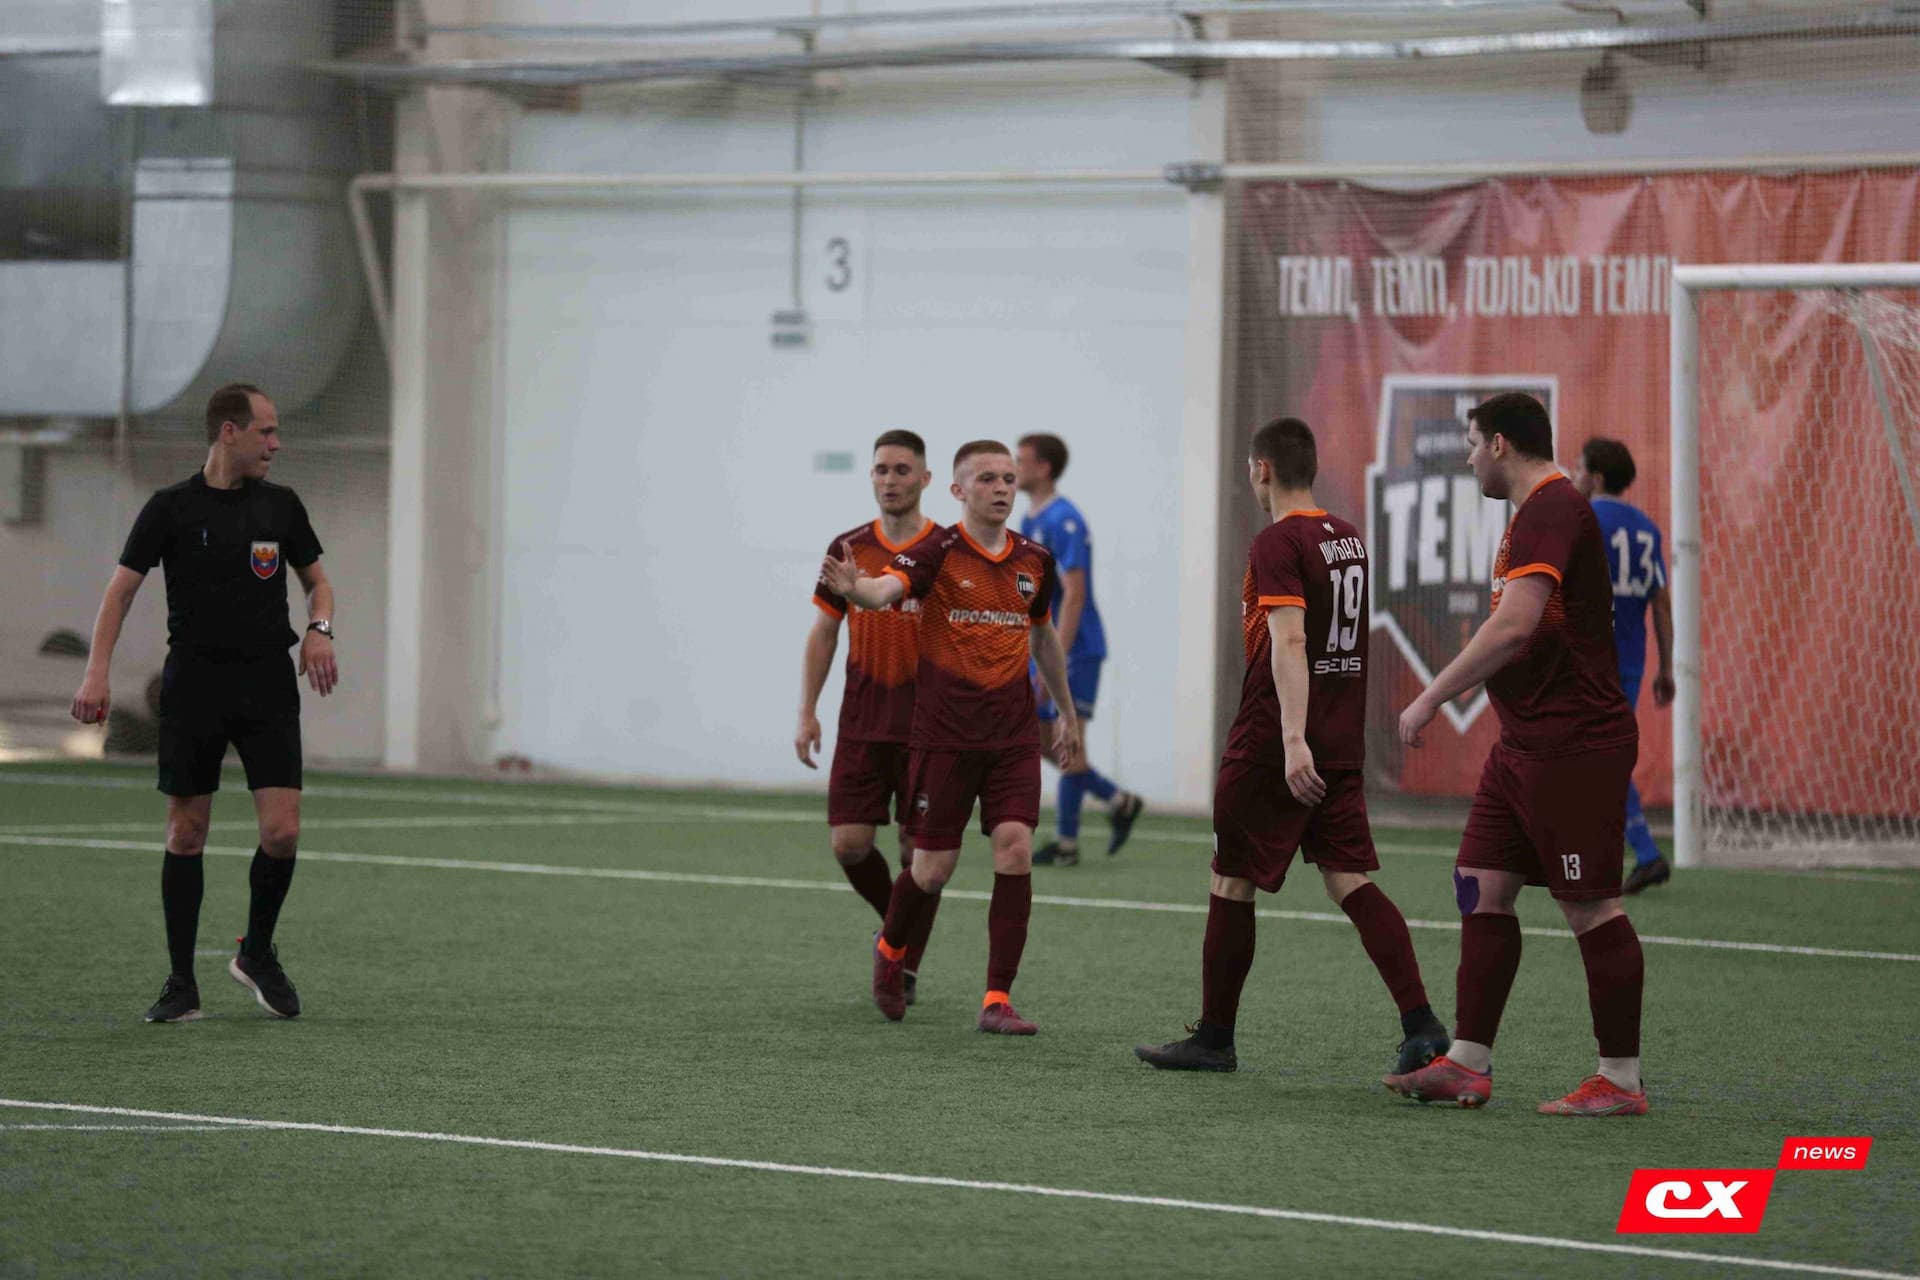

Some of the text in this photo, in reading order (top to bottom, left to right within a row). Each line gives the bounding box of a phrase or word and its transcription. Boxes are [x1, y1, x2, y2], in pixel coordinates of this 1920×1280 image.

[825, 236, 852, 292] 3
[1373, 255, 1457, 323] ТЕМП,
[1465, 254, 1580, 317] ТОЛЬКО
[1588, 254, 1677, 316] ТЕМП
[1318, 536, 1366, 565] ШИБАЕВ
[1383, 475, 1510, 591] ТЕМ
[1611, 526, 1655, 597] 13
[1326, 564, 1365, 652] 19
[1560, 853, 1582, 880] 13
